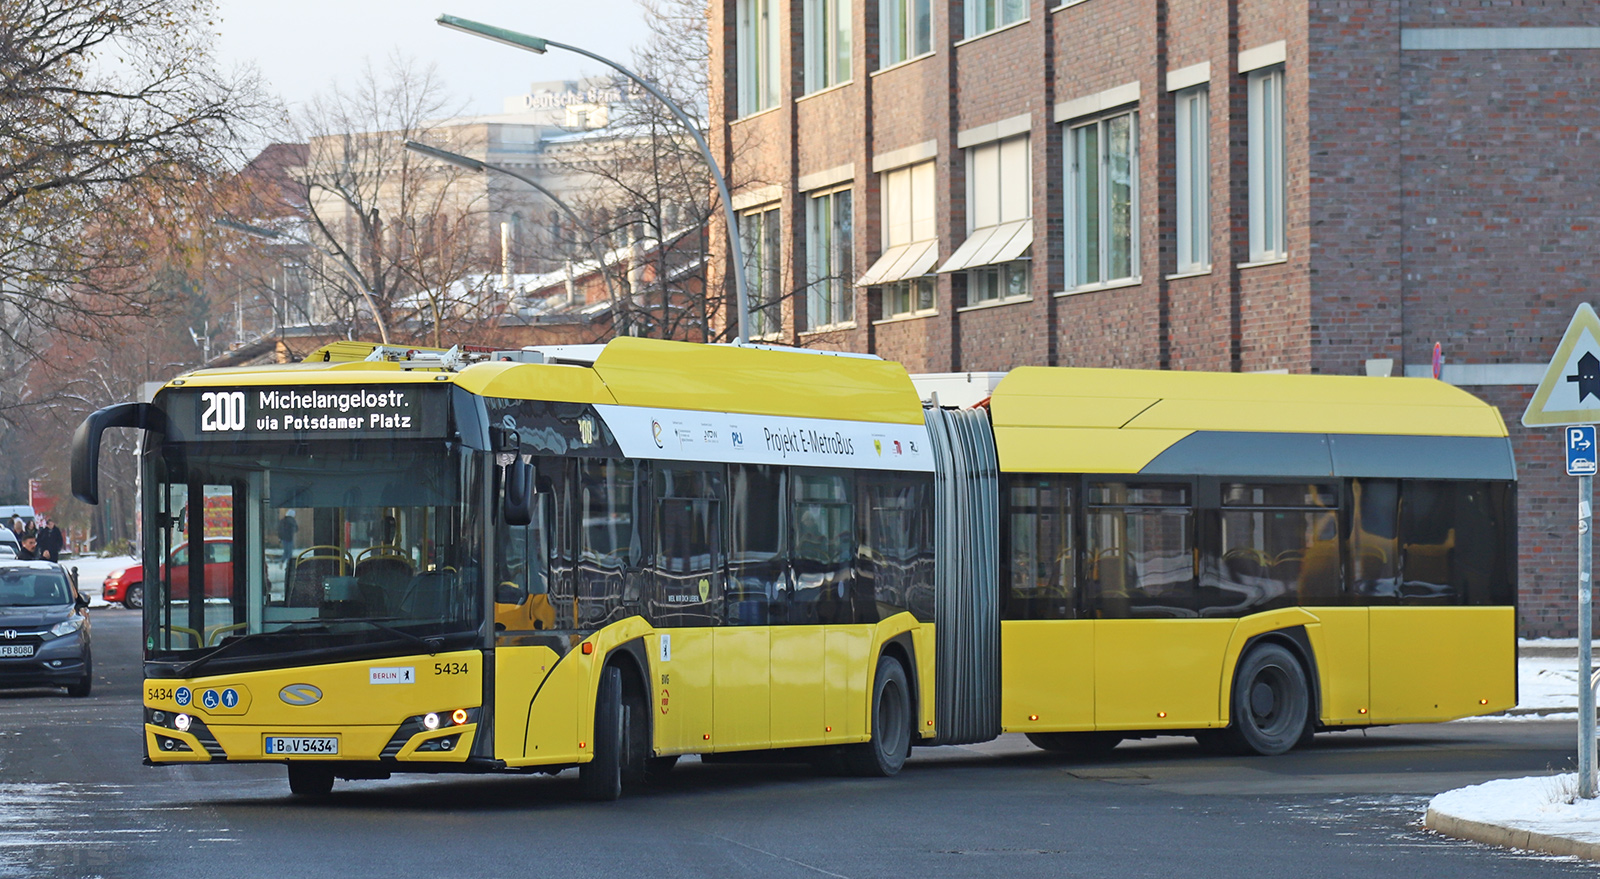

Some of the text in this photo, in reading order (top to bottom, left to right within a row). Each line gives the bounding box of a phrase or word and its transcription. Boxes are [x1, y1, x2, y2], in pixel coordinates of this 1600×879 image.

[523, 90, 584, 108] Deutsche
[201, 389, 409, 432] 200 Michelangelostr.
[256, 413, 411, 431] via Potsdamer Platz
[763, 427, 854, 458] Projekt E-MetroBus
[1571, 429, 1584, 448] P
[372, 672, 397, 680] BERLIN
[434, 662, 469, 675] 5434
[662, 674, 670, 684] BVG
[148, 688, 173, 700] 5434
[277, 738, 332, 752] B V 5434
